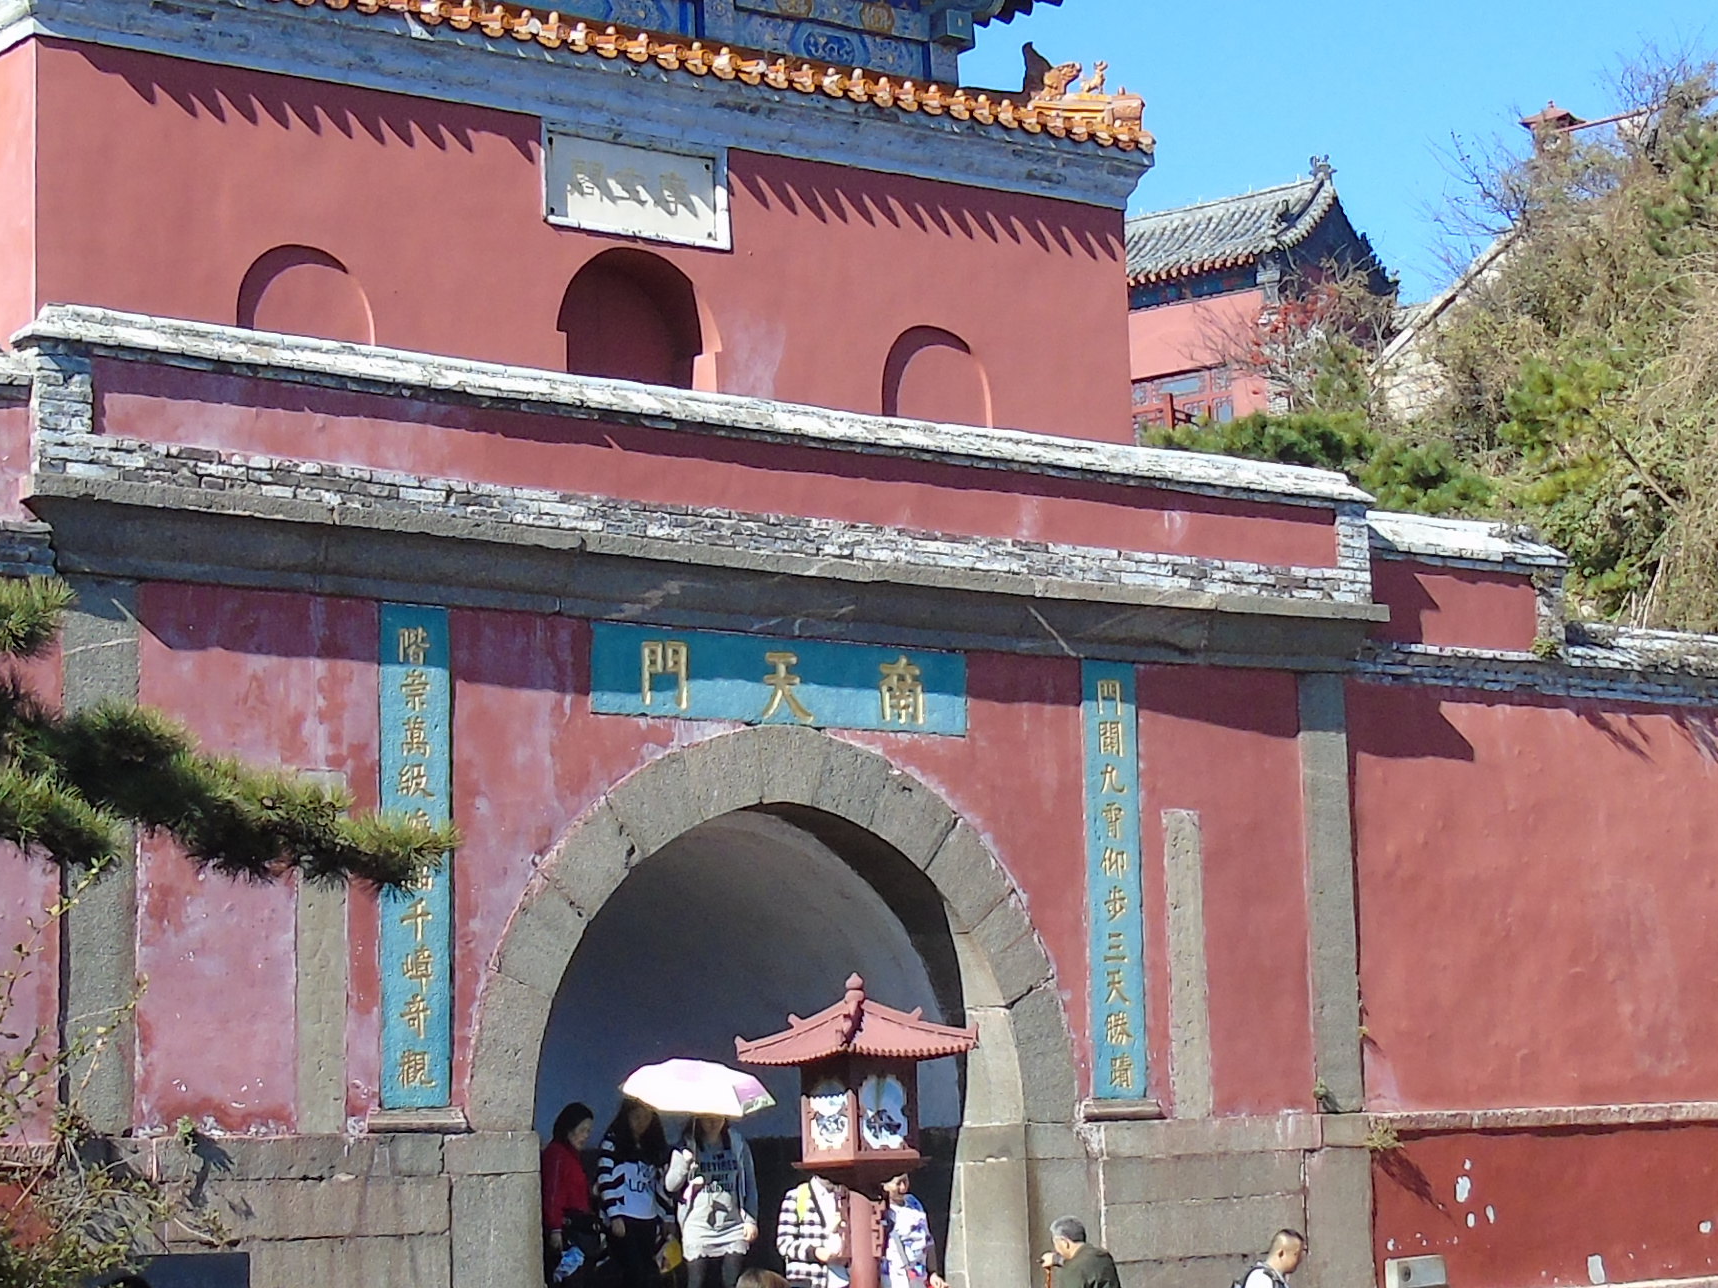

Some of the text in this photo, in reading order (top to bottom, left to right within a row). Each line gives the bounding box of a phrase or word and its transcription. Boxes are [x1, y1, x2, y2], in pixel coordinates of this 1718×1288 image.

[395, 625, 437, 1088] 階崇萬級千嶂奇觀
